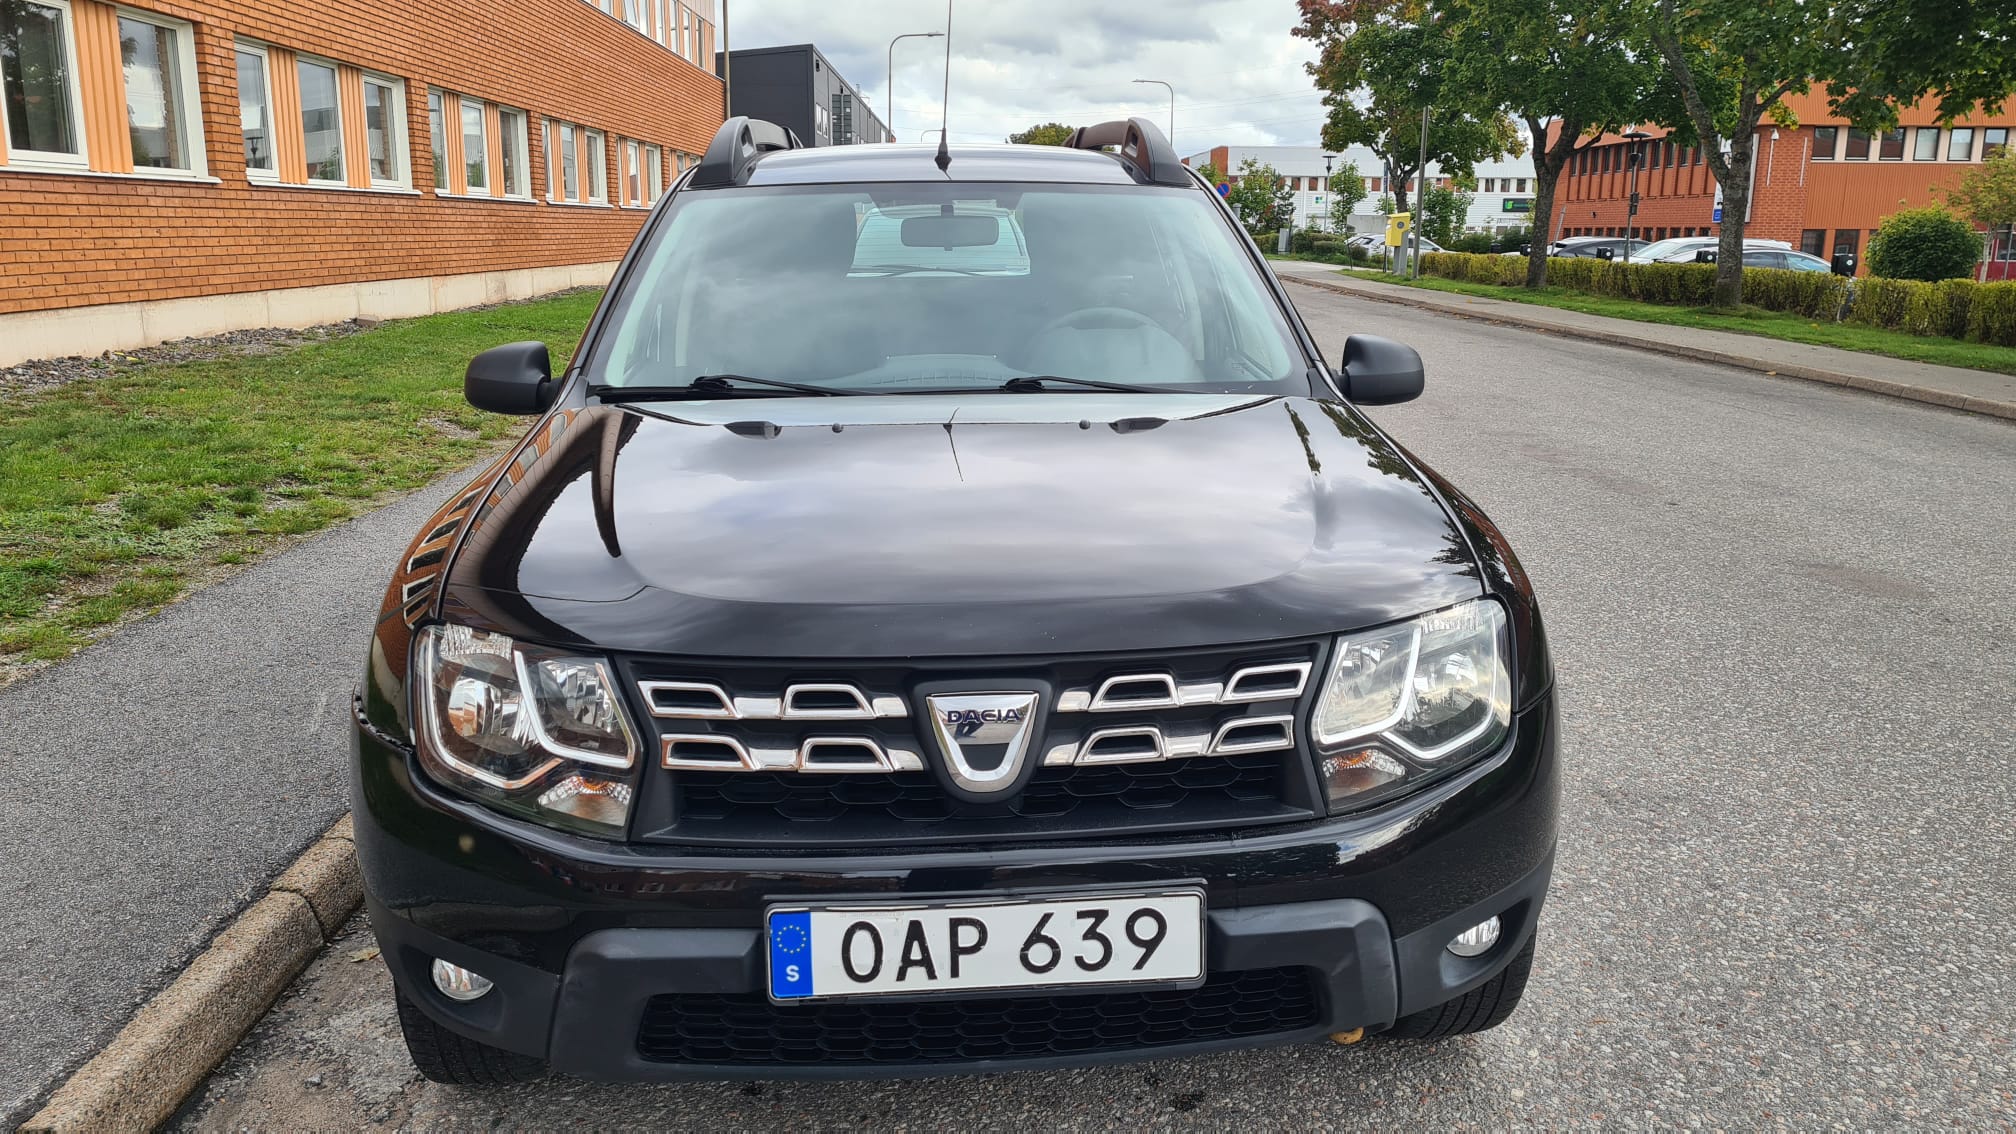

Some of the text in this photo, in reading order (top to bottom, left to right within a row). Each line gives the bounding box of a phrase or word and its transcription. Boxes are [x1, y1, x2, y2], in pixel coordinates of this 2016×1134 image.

[947, 709, 1020, 723] DACIA
[841, 907, 1168, 983] OAP 639
[786, 965, 800, 982] S
